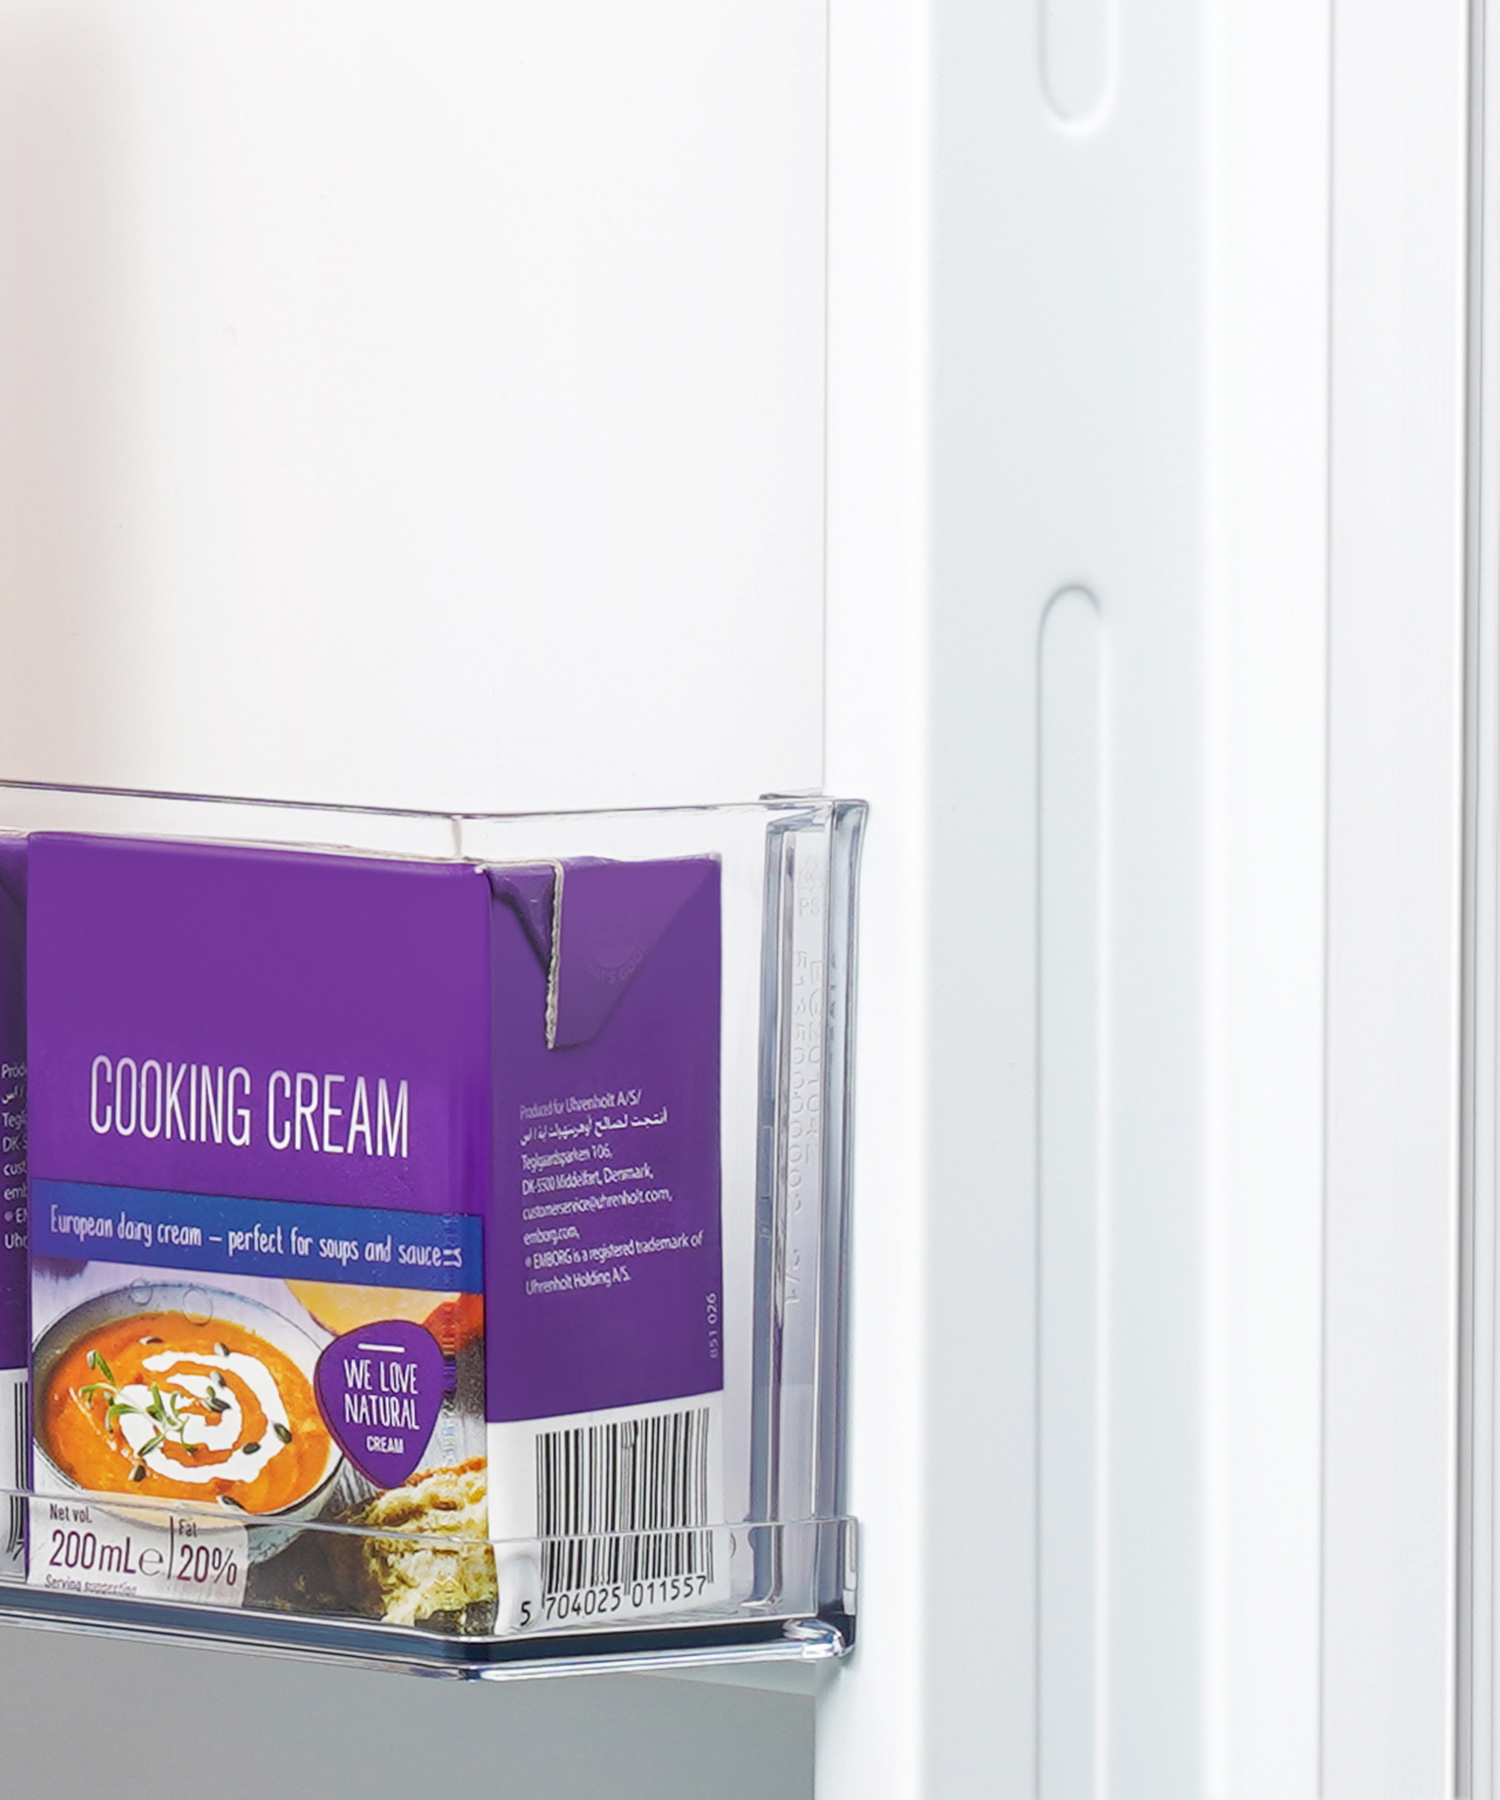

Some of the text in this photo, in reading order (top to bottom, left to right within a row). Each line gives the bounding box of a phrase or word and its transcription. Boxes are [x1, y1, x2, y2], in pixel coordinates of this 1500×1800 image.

[90, 1054, 408, 1158] COOKING CREAM
[50, 1204, 113, 1241] European
[117, 1211, 152, 1248] dairy
[156, 1221, 202, 1247] cream
[228, 1224, 283, 1257] perfect
[290, 1229, 313, 1257] for
[318, 1236, 358, 1266] soups
[363, 1237, 392, 1264] and
[533, 1248, 573, 1269] EMBORG
[589, 1239, 635, 1264] registered
[636, 1232, 689, 1255] trademark
[690, 1230, 704, 1247] of
[573, 1269, 611, 1288] Holding
[706, 1293, 718, 1325] 026
[344, 1359, 418, 1394] WE LOVE
[344, 1393, 420, 1430] NATURAL
[366, 1435, 404, 1454] CREAM
[49, 1503, 70, 1521] Net
[178, 1518, 198, 1538] Fat
[177, 1544, 238, 1586] 20%
[44, 1574, 82, 1592] Serving
[519, 1574, 707, 1626] 5 704025 011557
